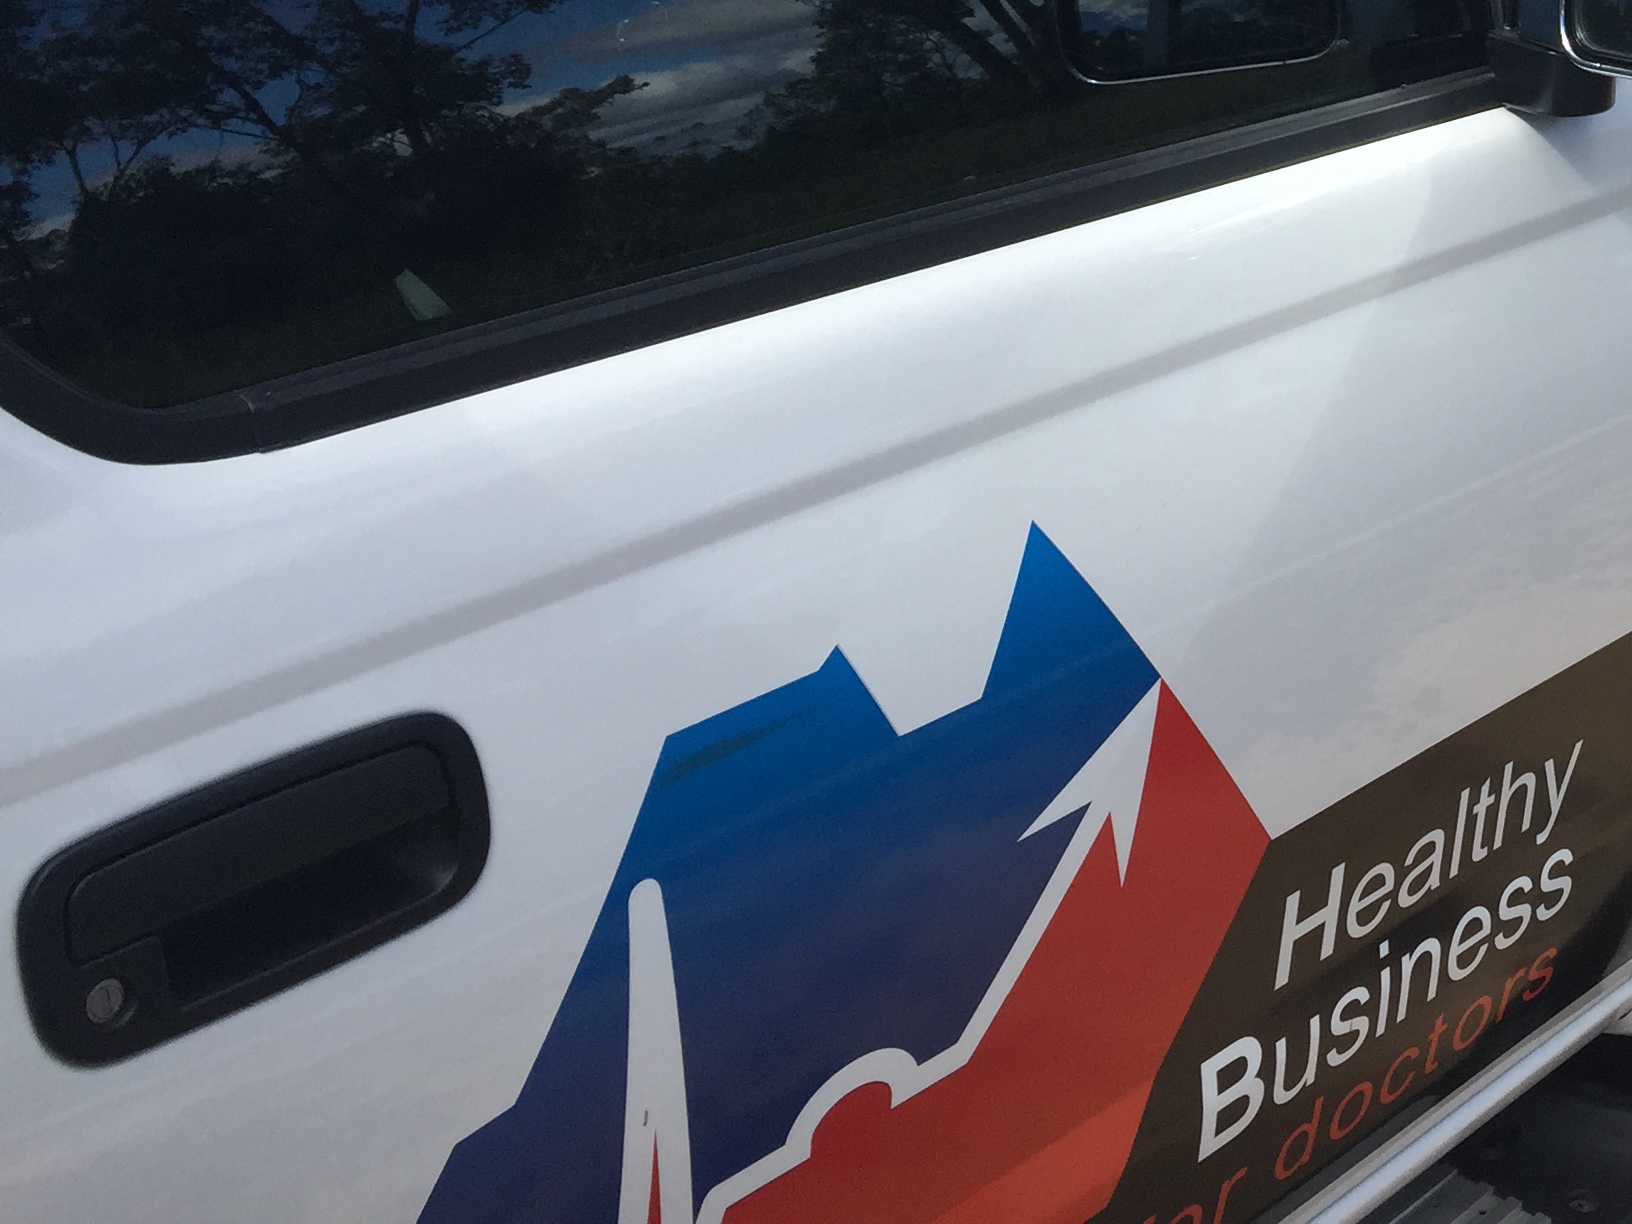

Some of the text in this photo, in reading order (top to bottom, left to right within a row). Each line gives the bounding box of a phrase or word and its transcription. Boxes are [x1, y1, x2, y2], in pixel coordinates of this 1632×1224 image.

[1274, 739, 1584, 991] Healthy
[1198, 848, 1574, 1163] Business
[1274, 947, 1558, 1181] doctors
